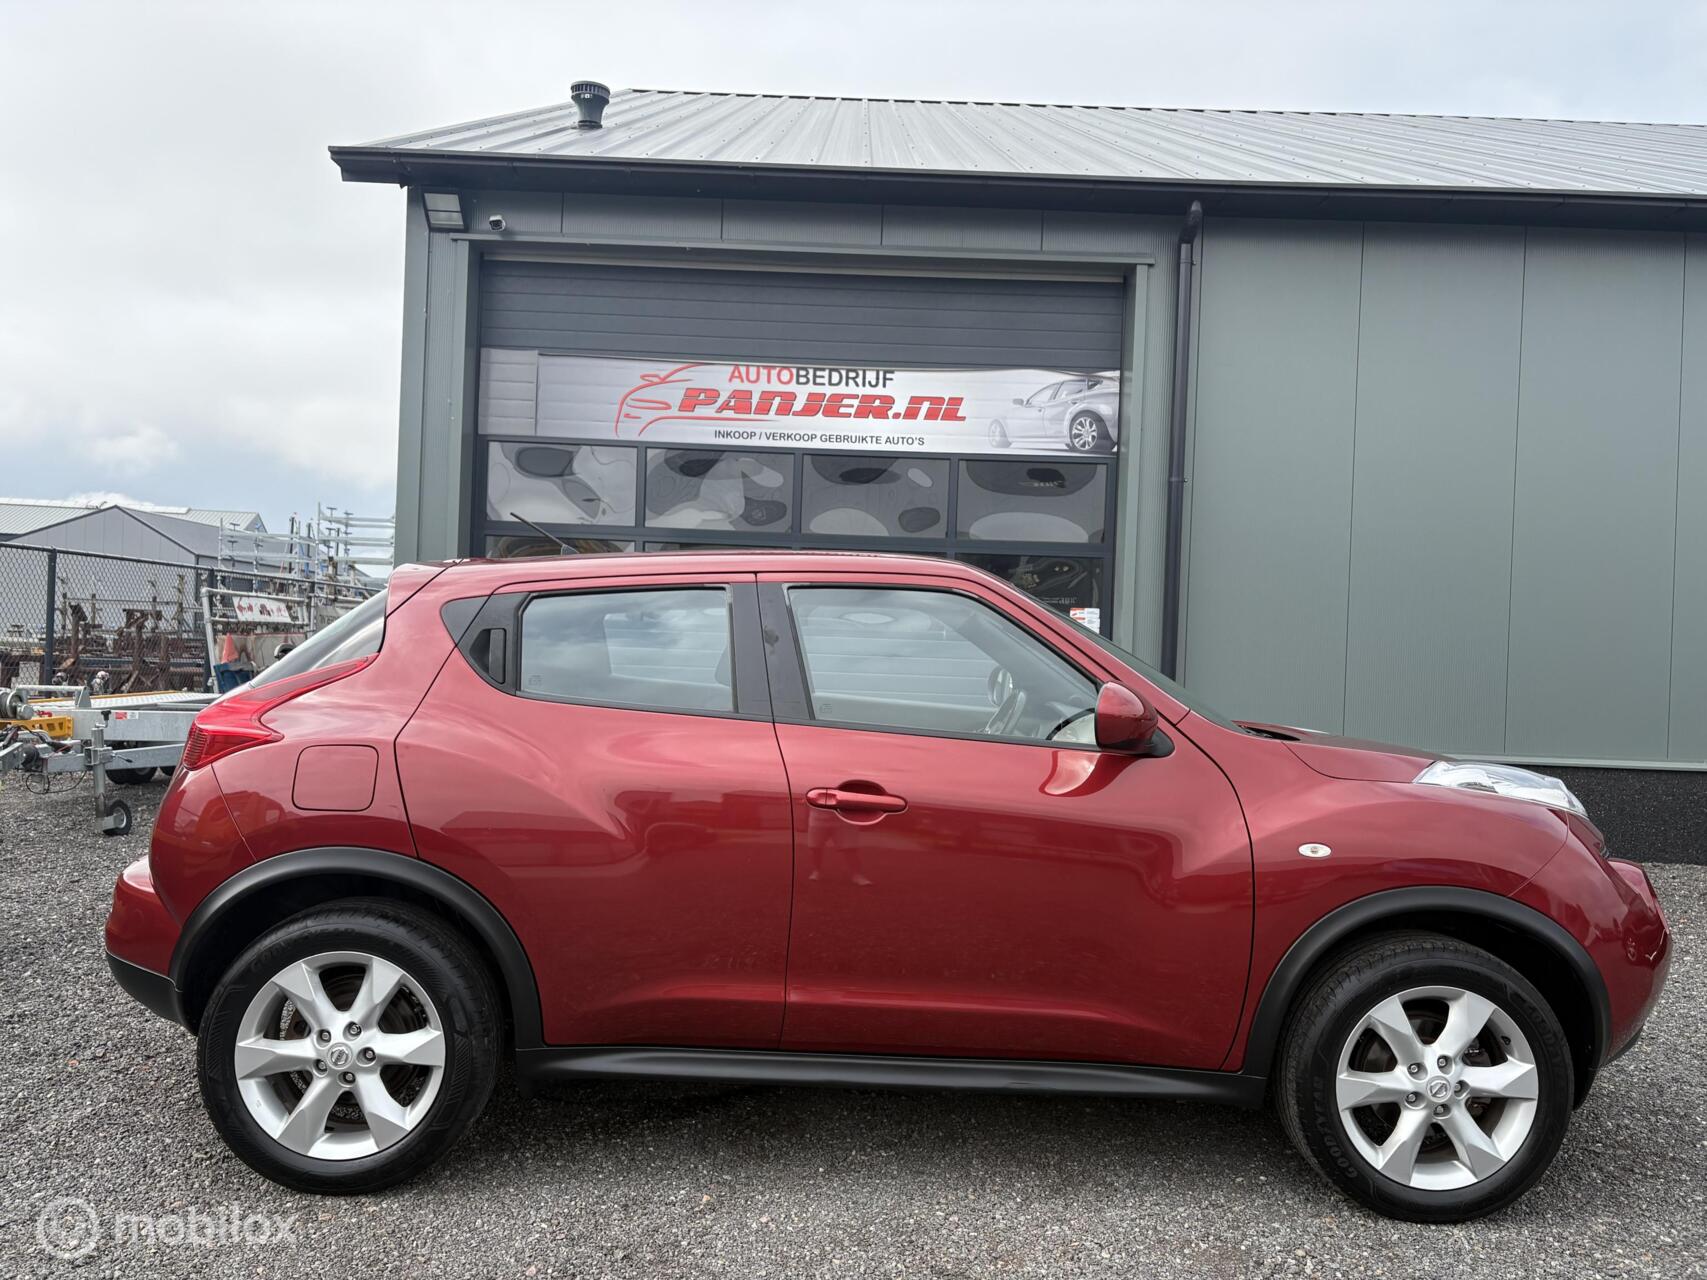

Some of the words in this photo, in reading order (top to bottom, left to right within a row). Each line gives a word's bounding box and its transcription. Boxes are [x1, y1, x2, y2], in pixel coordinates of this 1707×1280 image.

[728, 364, 896, 388] AUTOBEDRIJF
[714, 430, 757, 440] INKOOP
[764, 431, 817, 443] VERKOOP
[820, 433, 882, 445] GEBRUIKTE
[884, 436, 925, 446] AUTO'S
